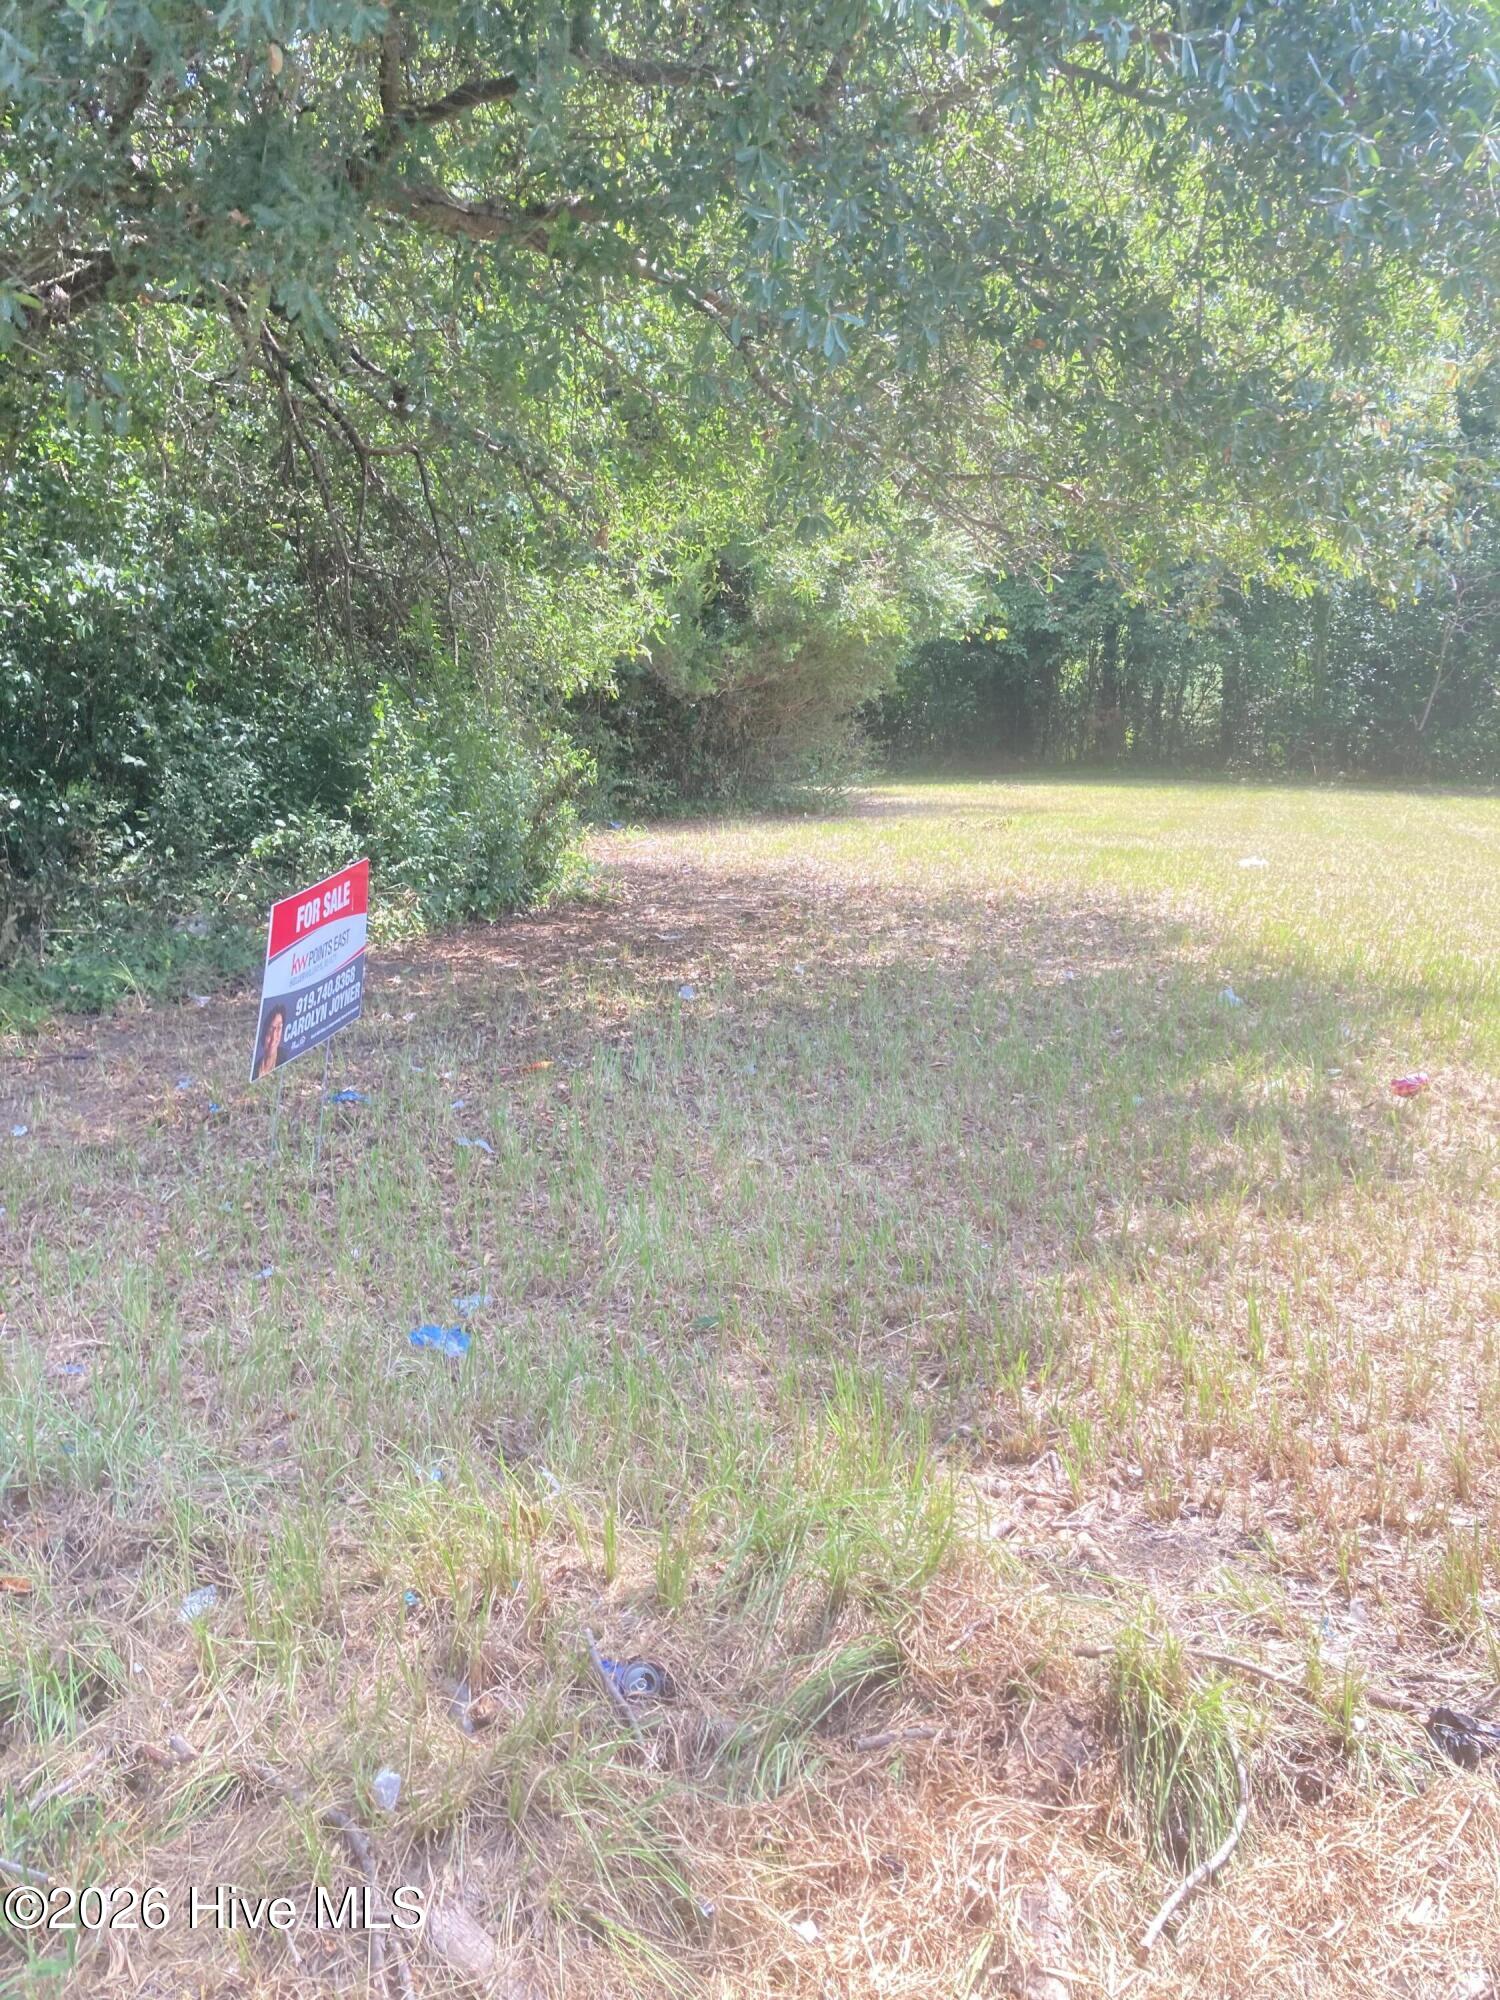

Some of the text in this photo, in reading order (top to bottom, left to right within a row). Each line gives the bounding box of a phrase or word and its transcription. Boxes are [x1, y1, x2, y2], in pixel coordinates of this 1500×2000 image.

[296, 880, 351, 933] FOR SALE
[308, 939, 333, 967] POINTS
[333, 928, 351, 952] EAST
[283, 1003, 328, 1042] CAROLYN
[328, 981, 361, 1016] JOYNER
[295, 966, 356, 1016] 919.740.8368
